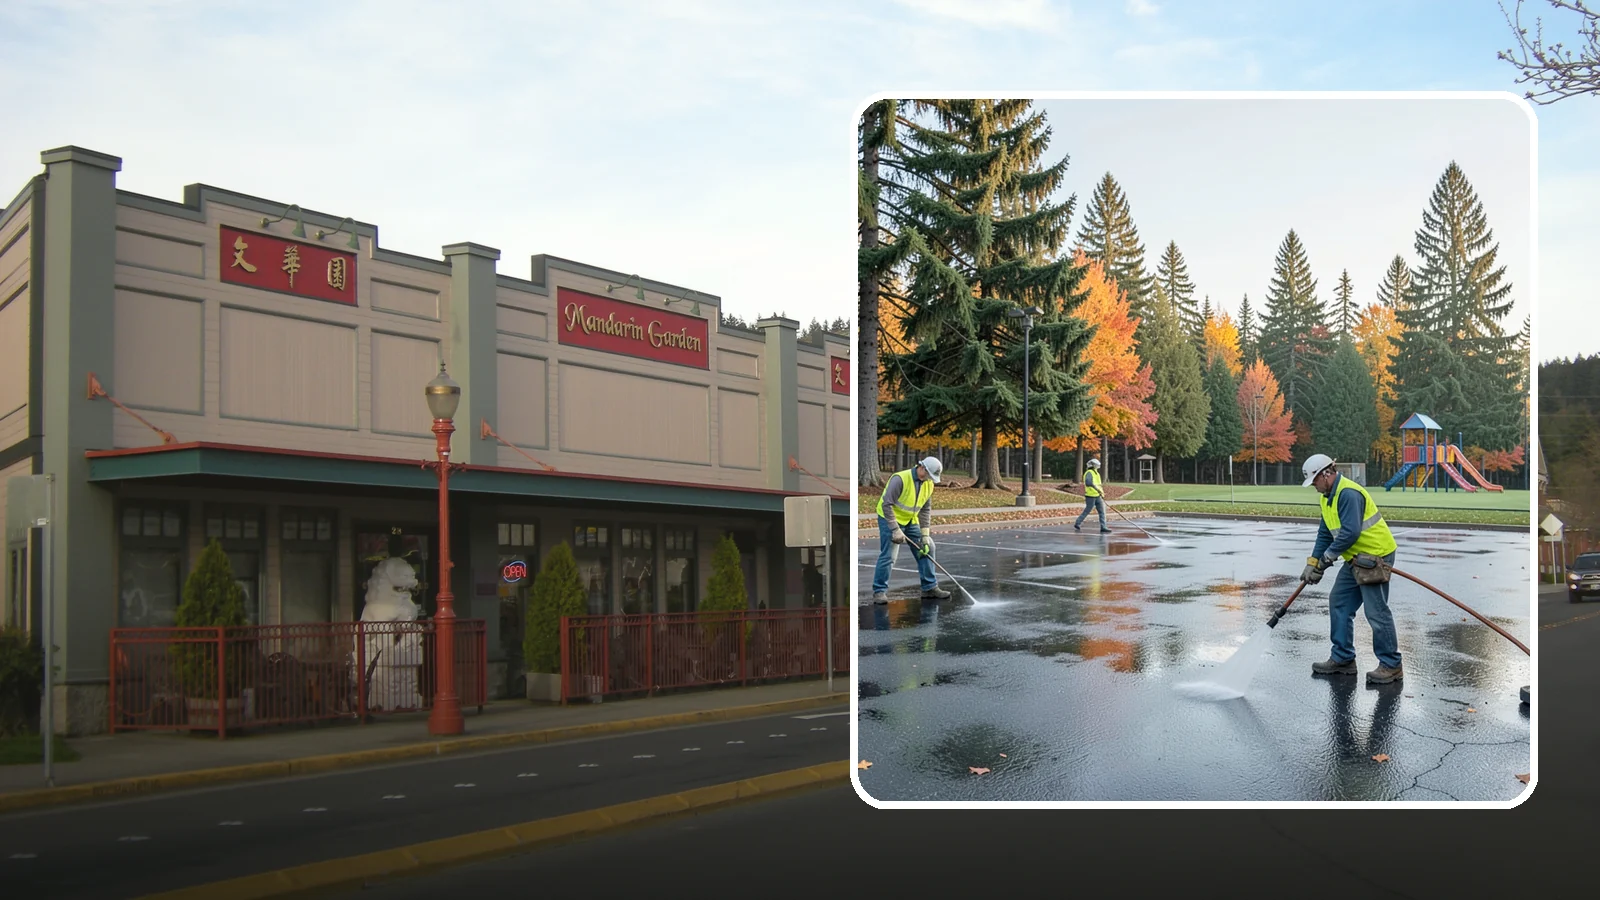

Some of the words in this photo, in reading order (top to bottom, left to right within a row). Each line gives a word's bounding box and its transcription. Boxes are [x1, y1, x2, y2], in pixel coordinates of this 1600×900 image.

[231, 235, 346, 291] 文華園
[564, 302, 644, 341] Mandarin
[647, 320, 701, 352] Garden
[503, 565, 527, 578] OPEN
